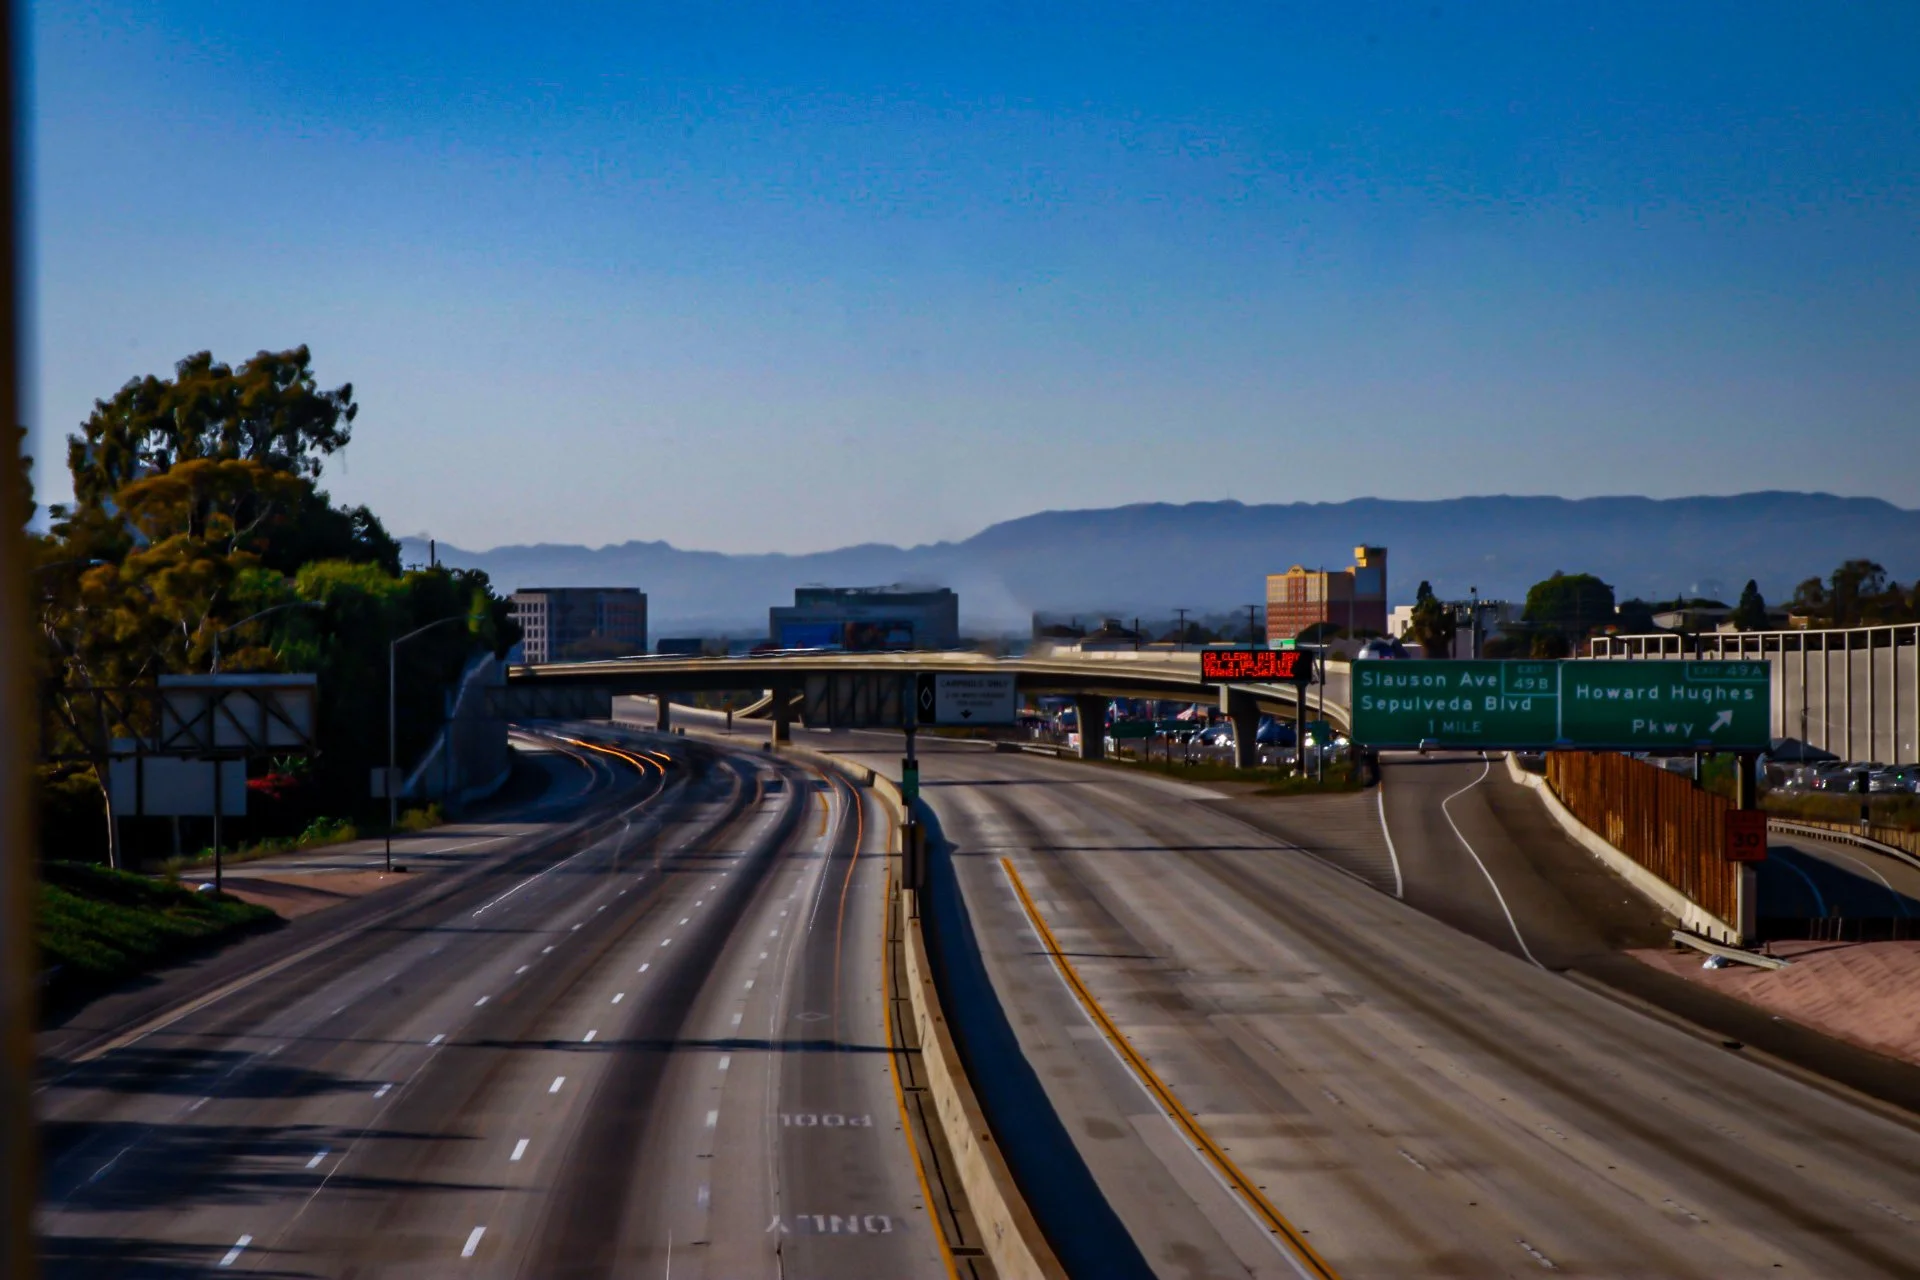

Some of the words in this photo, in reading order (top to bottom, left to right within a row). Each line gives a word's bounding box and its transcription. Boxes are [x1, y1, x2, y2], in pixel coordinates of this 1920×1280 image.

[1222, 652, 1252, 661] CLEAN
[1258, 652, 1276, 660] AIR
[1517, 664, 1545, 674] EXIT
[1361, 671, 1447, 688] Slauson
[1459, 671, 1499, 688] Ave
[1576, 684, 1660, 700] Howard
[1671, 684, 1755, 704] Hughes
[1361, 695, 1473, 714] Sepulveda
[1484, 695, 1532, 711] Blvd
[1428, 719, 1435, 734] 1
[1442, 720, 1483, 734] MILE
[1631, 719, 1694, 738] Pkwy
[1733, 833, 1759, 847] 30
[779, 1114, 873, 1127] POOL
[765, 1214, 893, 1233] ONLY
